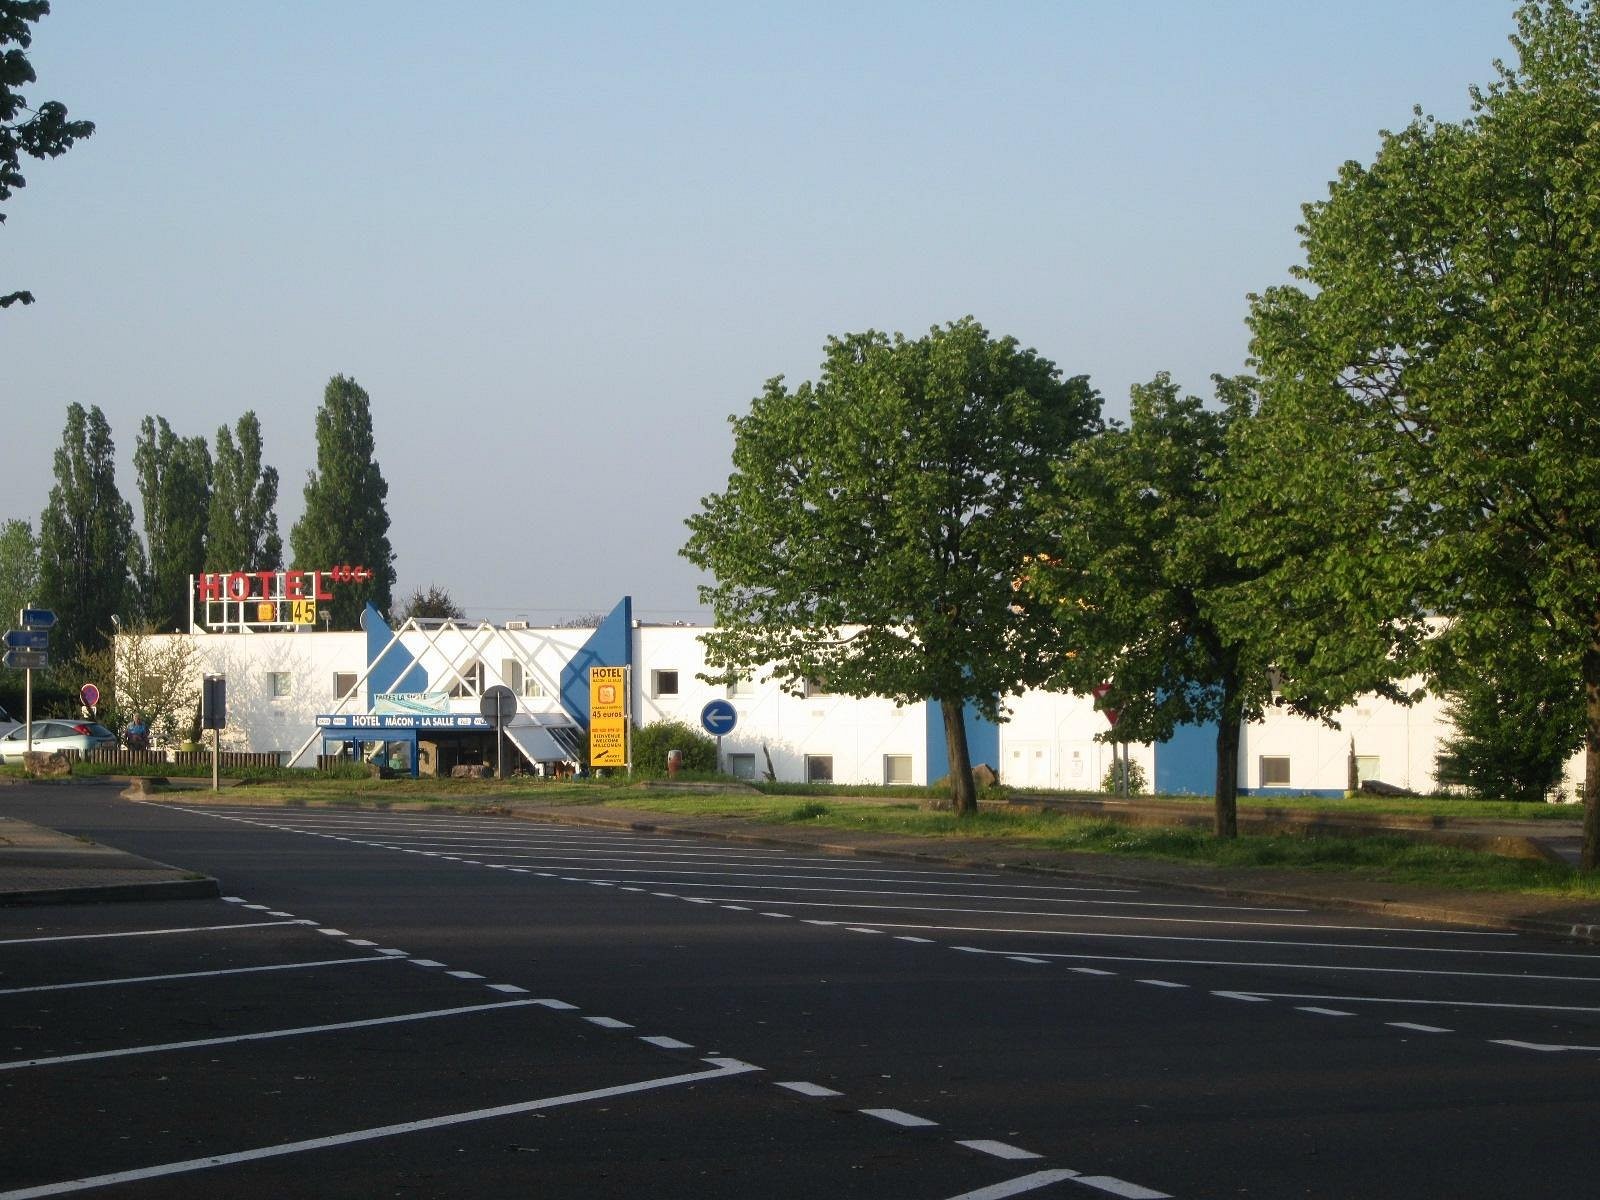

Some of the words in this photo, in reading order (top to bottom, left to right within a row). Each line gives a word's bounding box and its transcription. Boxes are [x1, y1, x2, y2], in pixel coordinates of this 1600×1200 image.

[198, 570, 333, 602] HOTEL
[294, 601, 315, 624] 45
[592, 668, 622, 678] HOTEL
[397, 693, 406, 702] LA
[592, 711, 601, 719] 45
[352, 715, 381, 727] HOTEL
[421, 717, 431, 727] LA
[432, 717, 455, 727] SALLE
